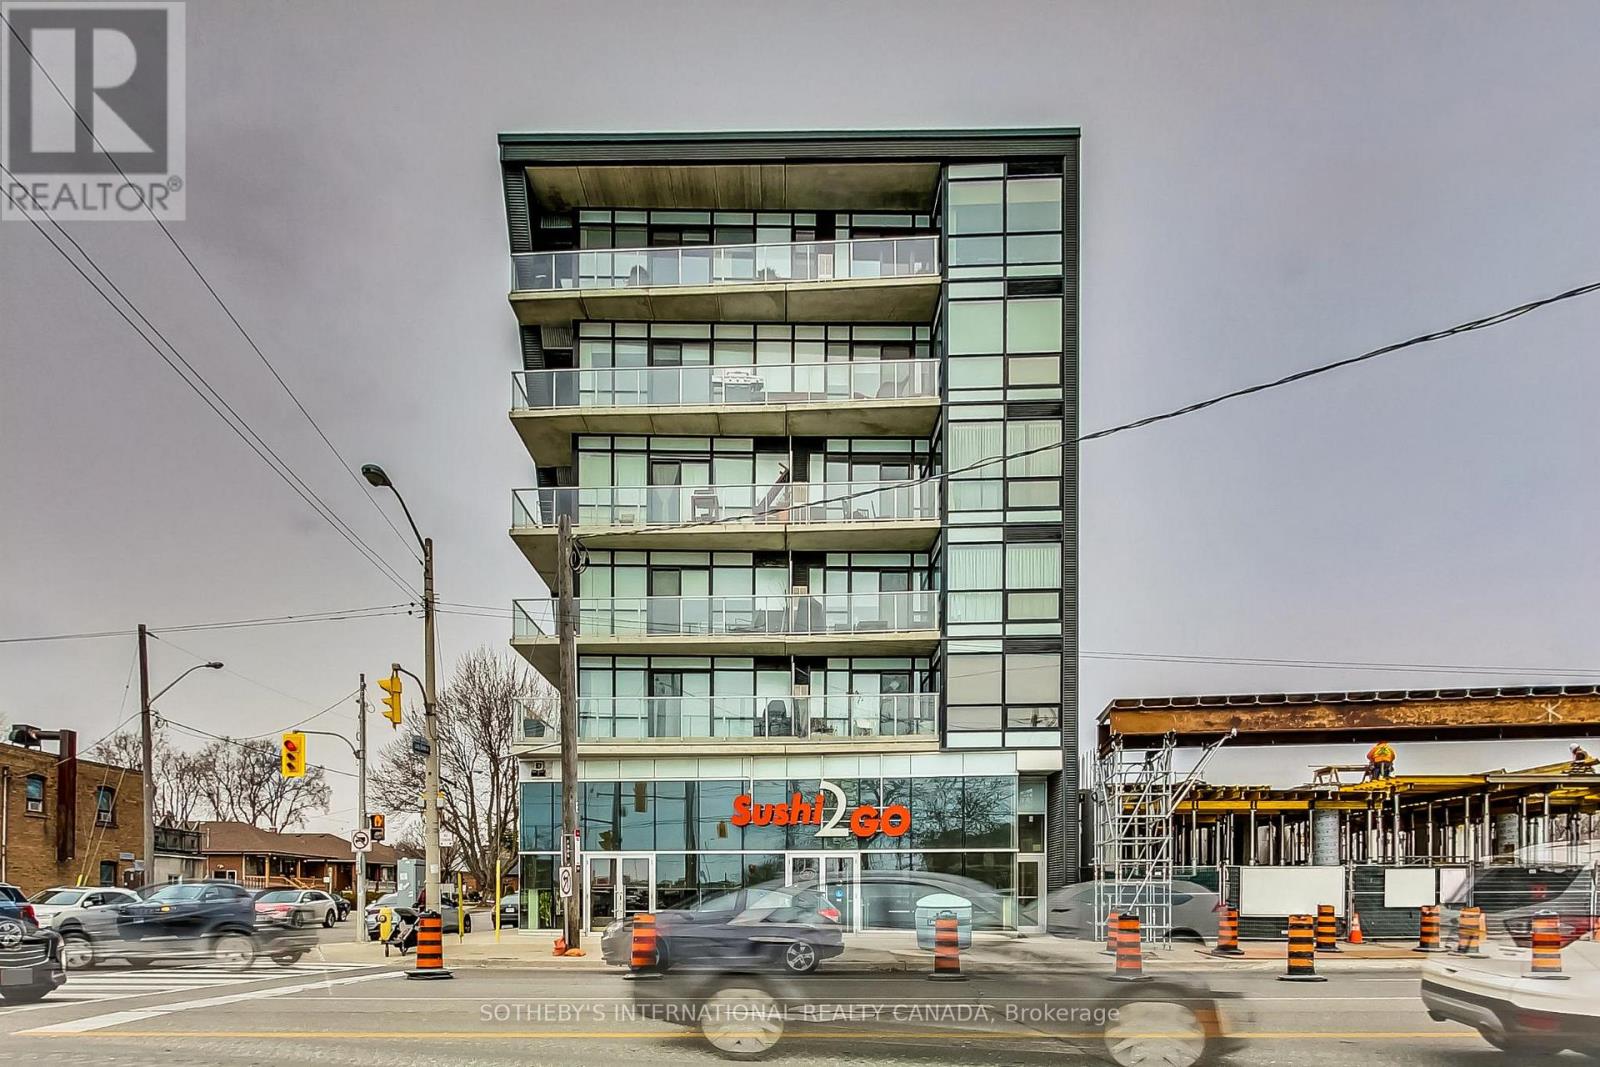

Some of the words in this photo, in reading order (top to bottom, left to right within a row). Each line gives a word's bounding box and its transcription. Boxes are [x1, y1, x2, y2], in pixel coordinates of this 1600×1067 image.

[731, 791, 825, 827] Sushi
[814, 780, 849, 837] 2
[850, 804, 912, 838] GO
